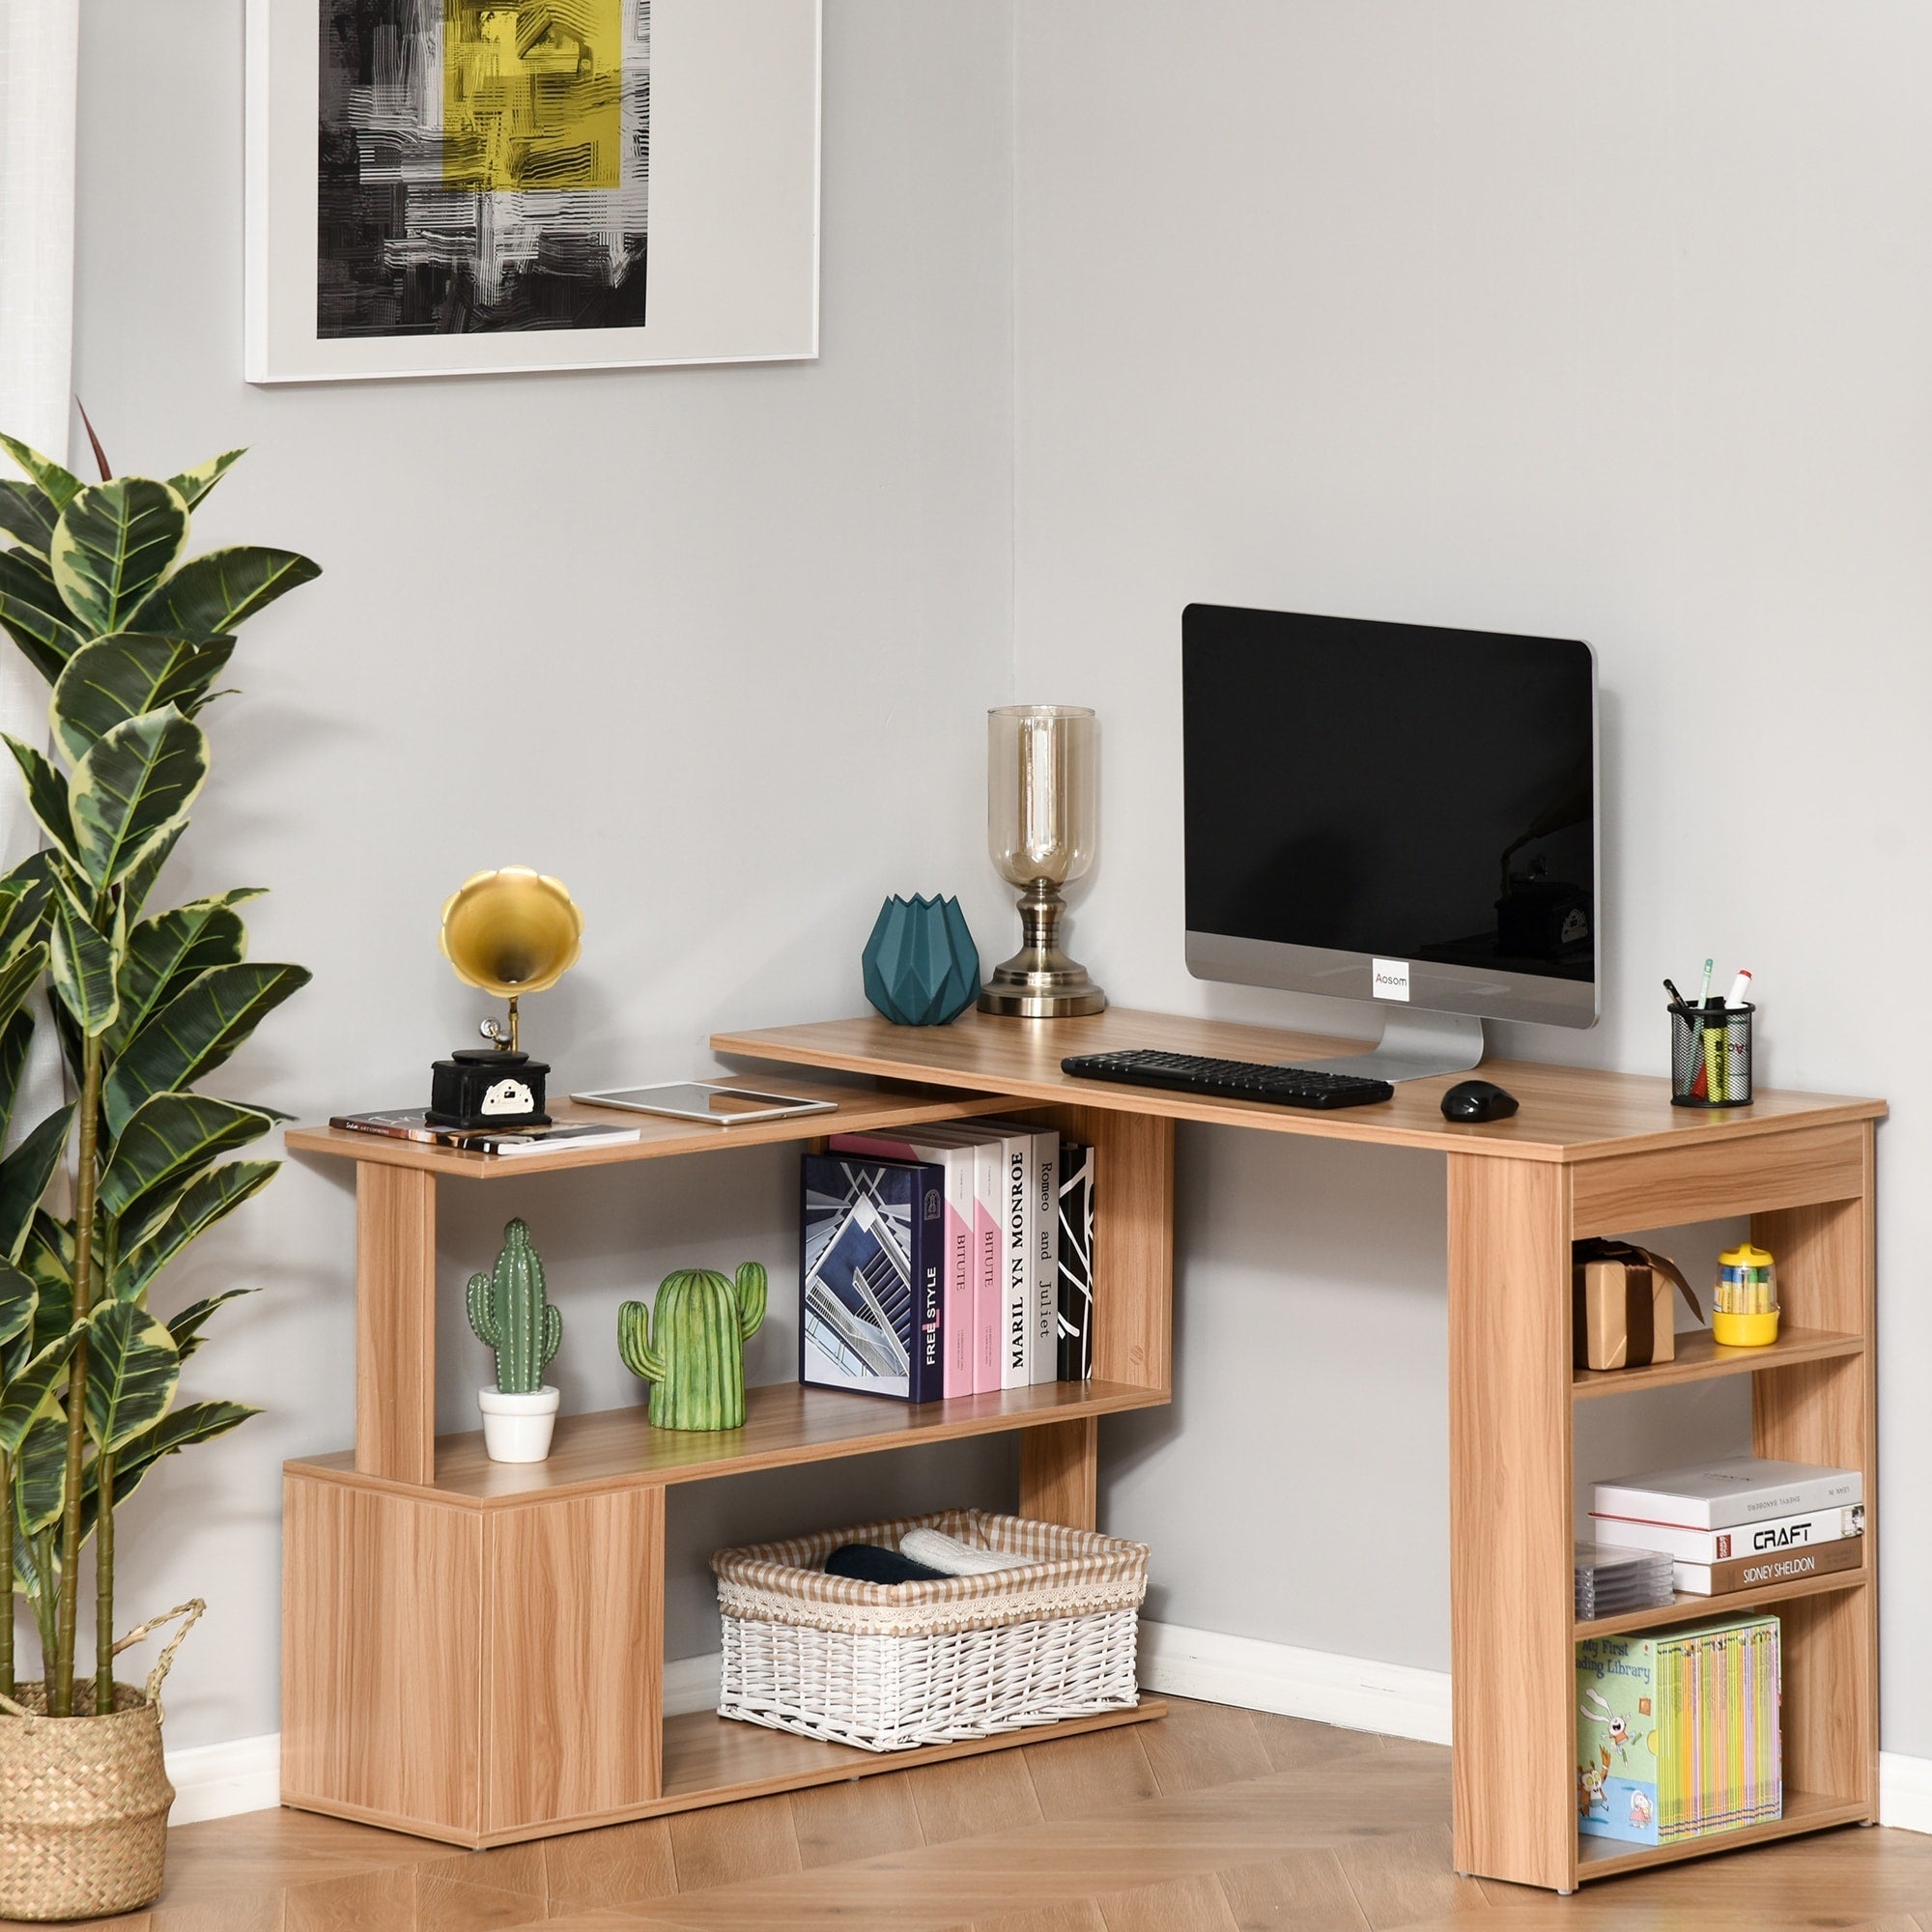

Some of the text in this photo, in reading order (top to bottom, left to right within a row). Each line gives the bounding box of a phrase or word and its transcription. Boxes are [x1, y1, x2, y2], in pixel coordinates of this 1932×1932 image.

[1376, 973, 1407, 986] Aosom
[1011, 1151, 1024, 1249] MONROE
[956, 1235, 966, 1292] BITUTE
[984, 1231, 994, 1288] BITUTE
[1039, 1161, 1053, 1339] Romeo and Juliet
[926, 1266, 937, 1365] FREE STYLE
[1753, 1522, 1812, 1550] CRAFT
[1743, 1563, 1774, 1584] SIDNEY
[1774, 1556, 1815, 1577] SHELDON
[1582, 1638, 1629, 1658] My First
[1606, 1659, 1651, 1685] Library
